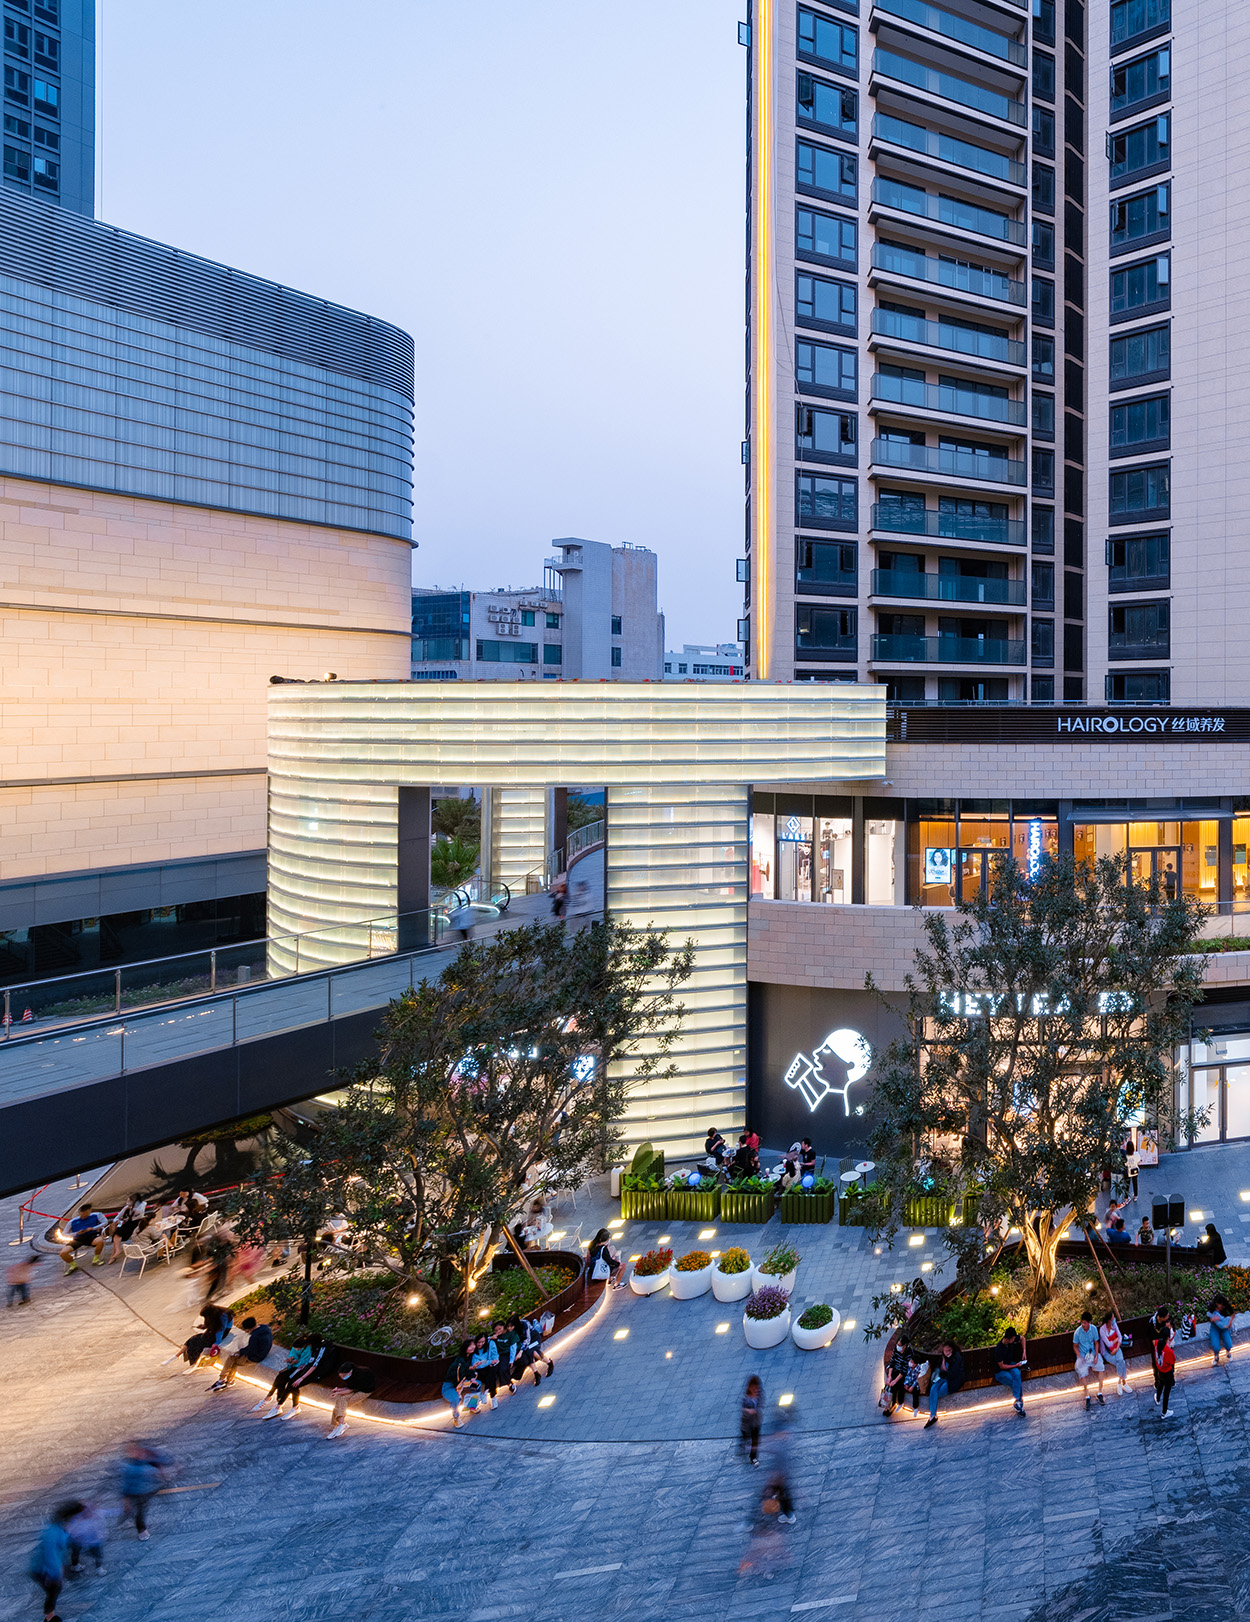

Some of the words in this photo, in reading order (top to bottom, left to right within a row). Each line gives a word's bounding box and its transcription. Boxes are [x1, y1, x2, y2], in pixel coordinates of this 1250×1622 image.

[1057, 716, 1170, 733] HAIROLOGY
[1171, 717, 1226, 733] 丝域养发
[1030, 822, 1041, 882] HAIROLOG
